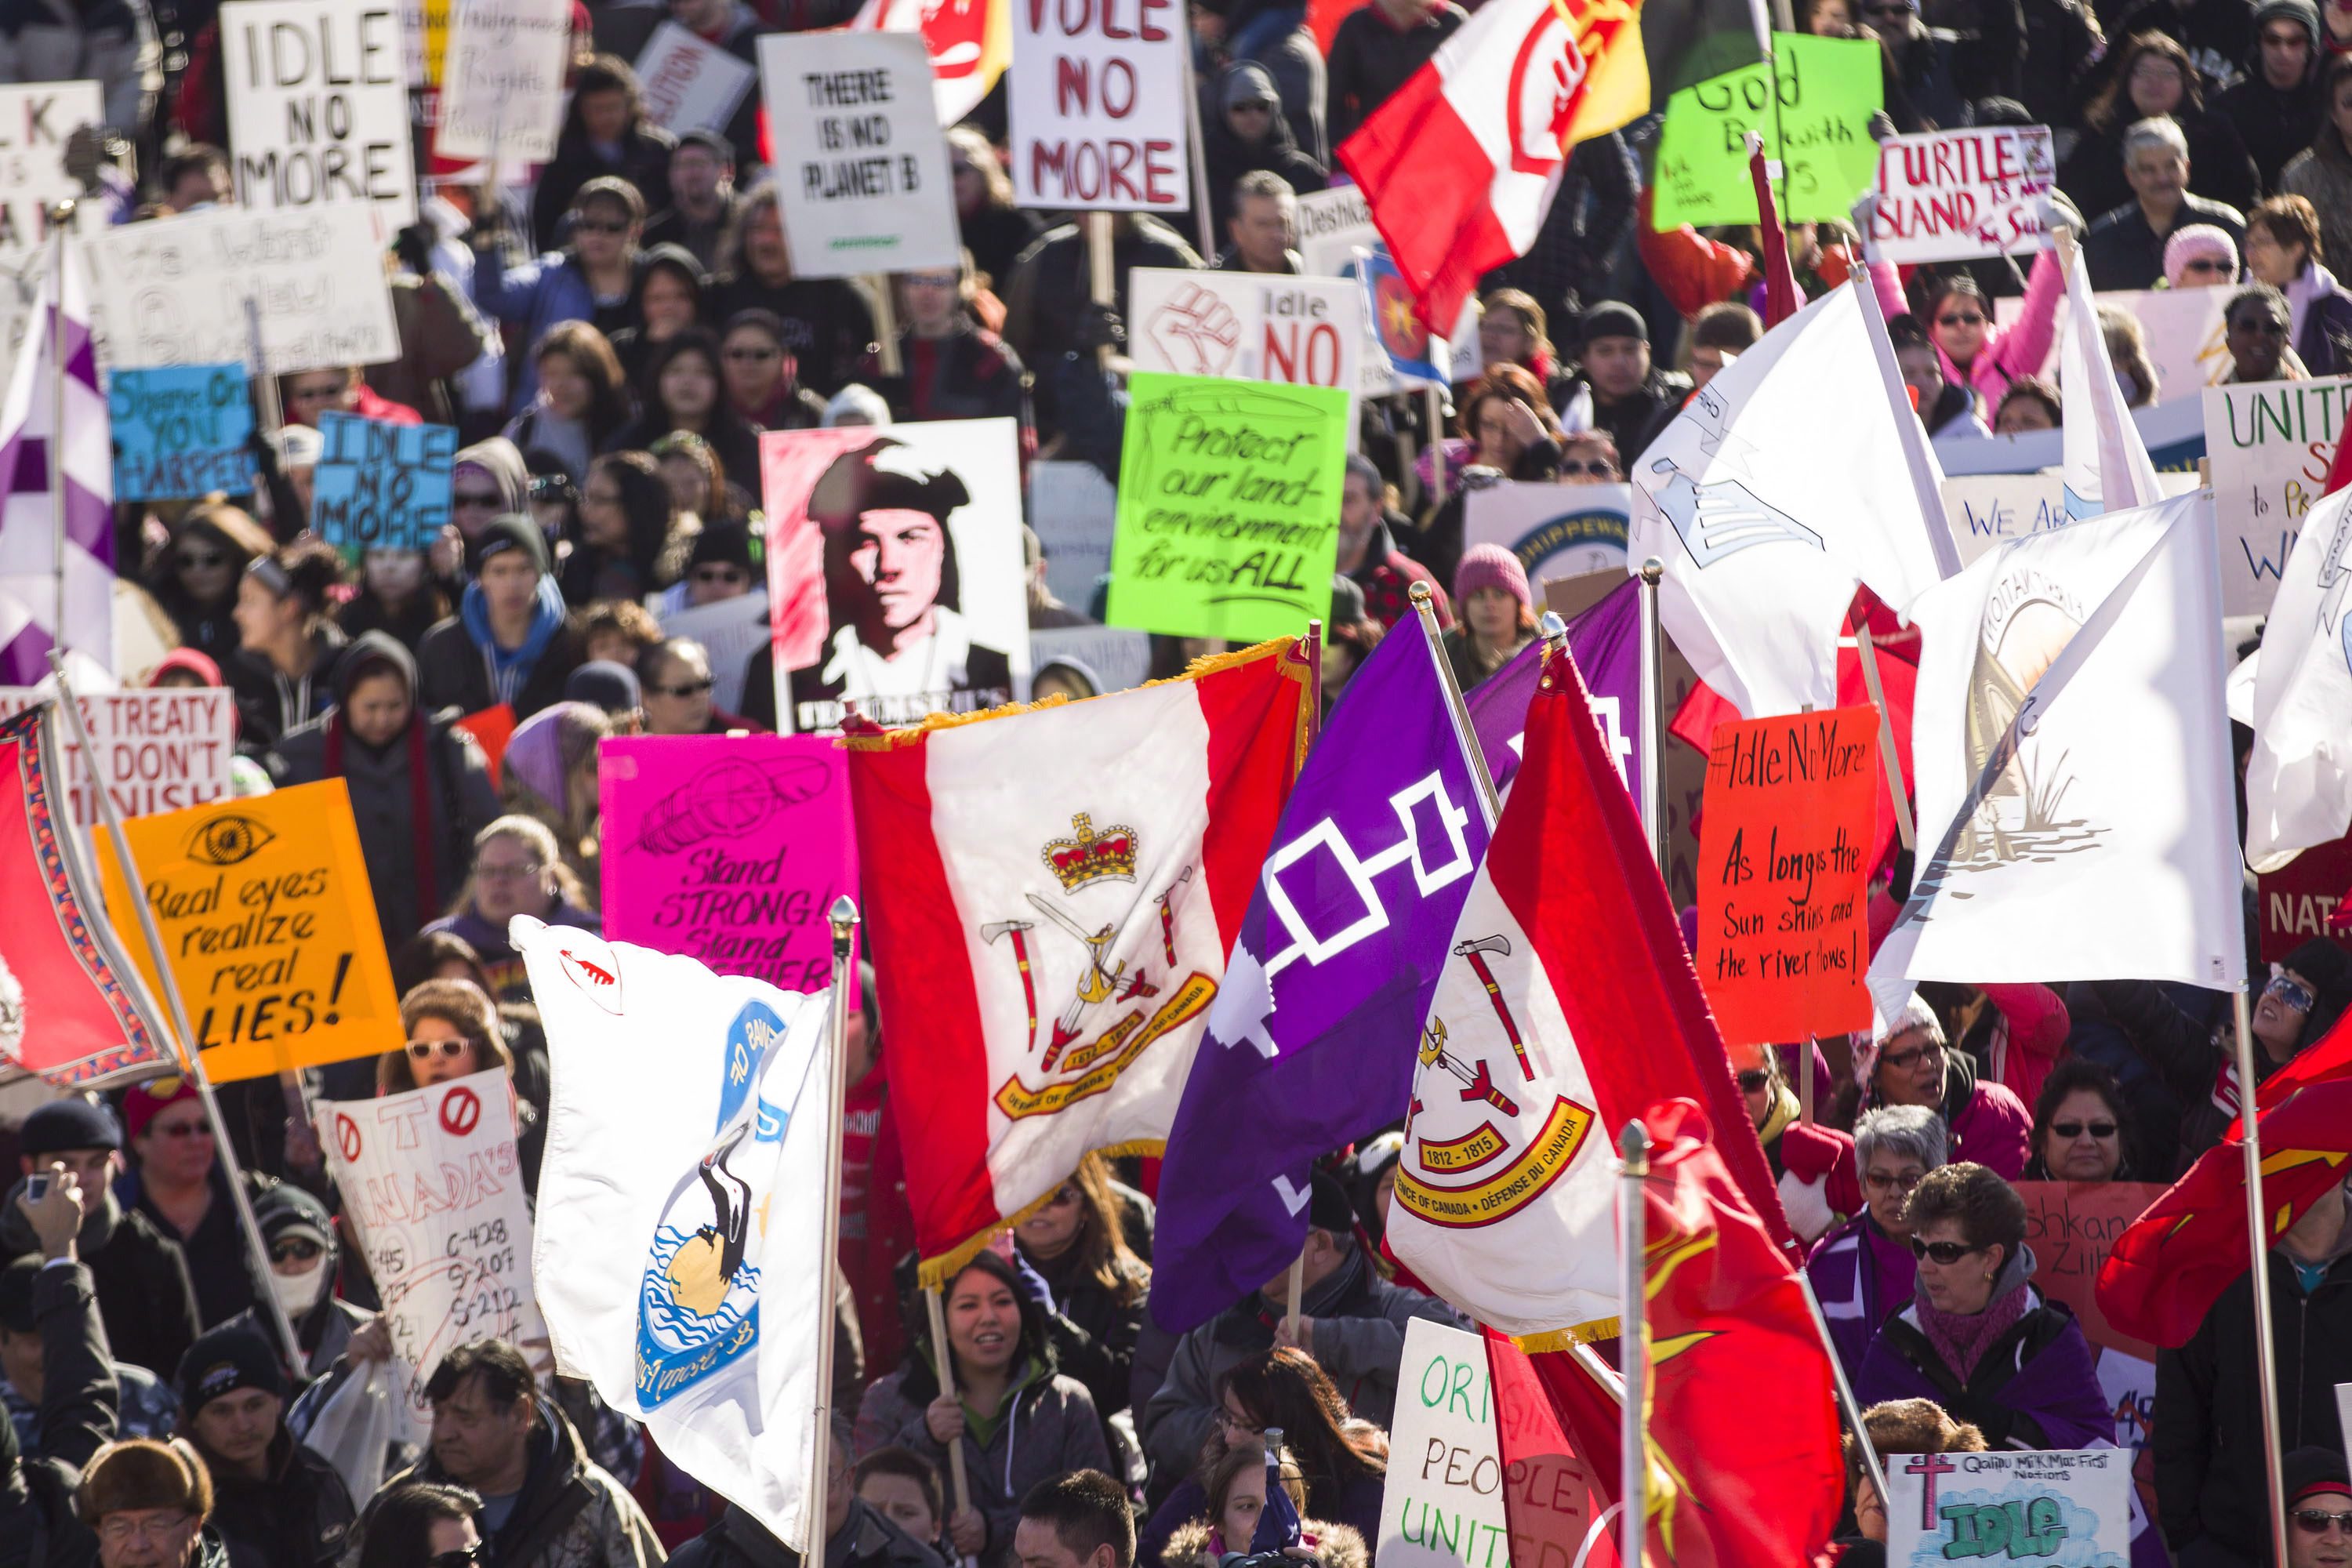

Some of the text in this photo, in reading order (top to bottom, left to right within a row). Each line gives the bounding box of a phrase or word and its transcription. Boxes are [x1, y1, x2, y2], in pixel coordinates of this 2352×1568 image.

[1029, 0, 1171, 40] IDLE
[245, 12, 393, 88] IDLE
[804, 67, 892, 107] THERE
[1057, 56, 1137, 118] NO
[288, 95, 354, 143] NO
[239, 143, 398, 207] MORE
[1032, 140, 1176, 203] MORE
[1879, 136, 2020, 196] TURTLE
[1264, 290, 1329, 318] Idle
[1263, 321, 1341, 388] NO
[332, 419, 450, 474] IDLE
[1172, 417, 1319, 465] Protect
[356, 470, 415, 508] NO
[1161, 468, 1228, 498] our
[1963, 496, 2015, 536] WE
[1228, 550, 1305, 590] ALL
[105, 695, 220, 735] TREATY
[114, 740, 220, 782] DON'T
[681, 845, 786, 885] Stand
[1722, 827, 1754, 885] As
[1768, 826, 1817, 906] long
[1831, 826, 1860, 873] the
[146, 867, 329, 920] Real eyes
[654, 880, 834, 927] STRONG!
[181, 911, 317, 958] realize
[1724, 902, 1763, 938] Sun
[210, 948, 299, 996] real
[1716, 947, 1749, 980] the
[1759, 946, 1812, 979] river
[197, 952, 353, 1051] LIES!
[1418, 1194, 1431, 1210] OF
[1432, 1200, 1472, 1215] CANADA
[1527, 1162, 1545, 1181] DU
[1542, 1118, 1578, 1166] CANADA
[1427, 1149, 1453, 1165] 1812
[1464, 1135, 1494, 1160] 1815
[446, 1219, 508, 1258] C-428
[448, 1247, 514, 1290] S-207
[451, 1287, 525, 1327] S-212
[2013, 1470, 2071, 1481] Nations
[2078, 1454, 2109, 1469] First
